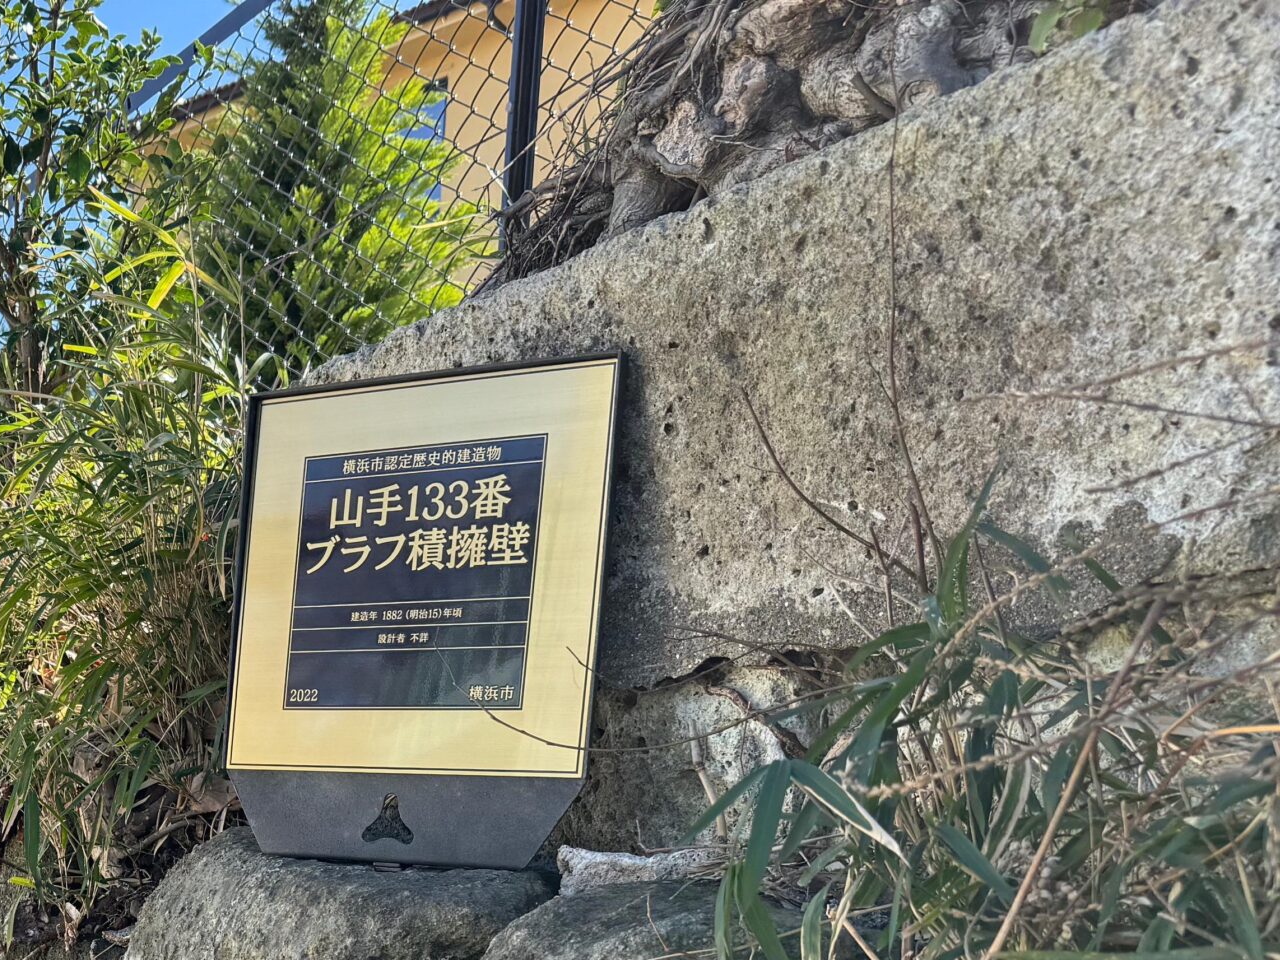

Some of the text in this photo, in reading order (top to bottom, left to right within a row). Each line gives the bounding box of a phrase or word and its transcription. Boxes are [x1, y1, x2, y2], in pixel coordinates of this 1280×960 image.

[342, 445, 503, 475] 横浜市認定歴史的建造物
[329, 473, 512, 530] 山手133番
[306, 520, 531, 576] ブラフ積擁壁
[350, 611, 378, 622] 建造年
[382, 610, 403, 621] 1882
[377, 632, 429, 644] 設計者 不詳
[290, 688, 319, 702] 2022
[469, 685, 515, 701] 横浜市
